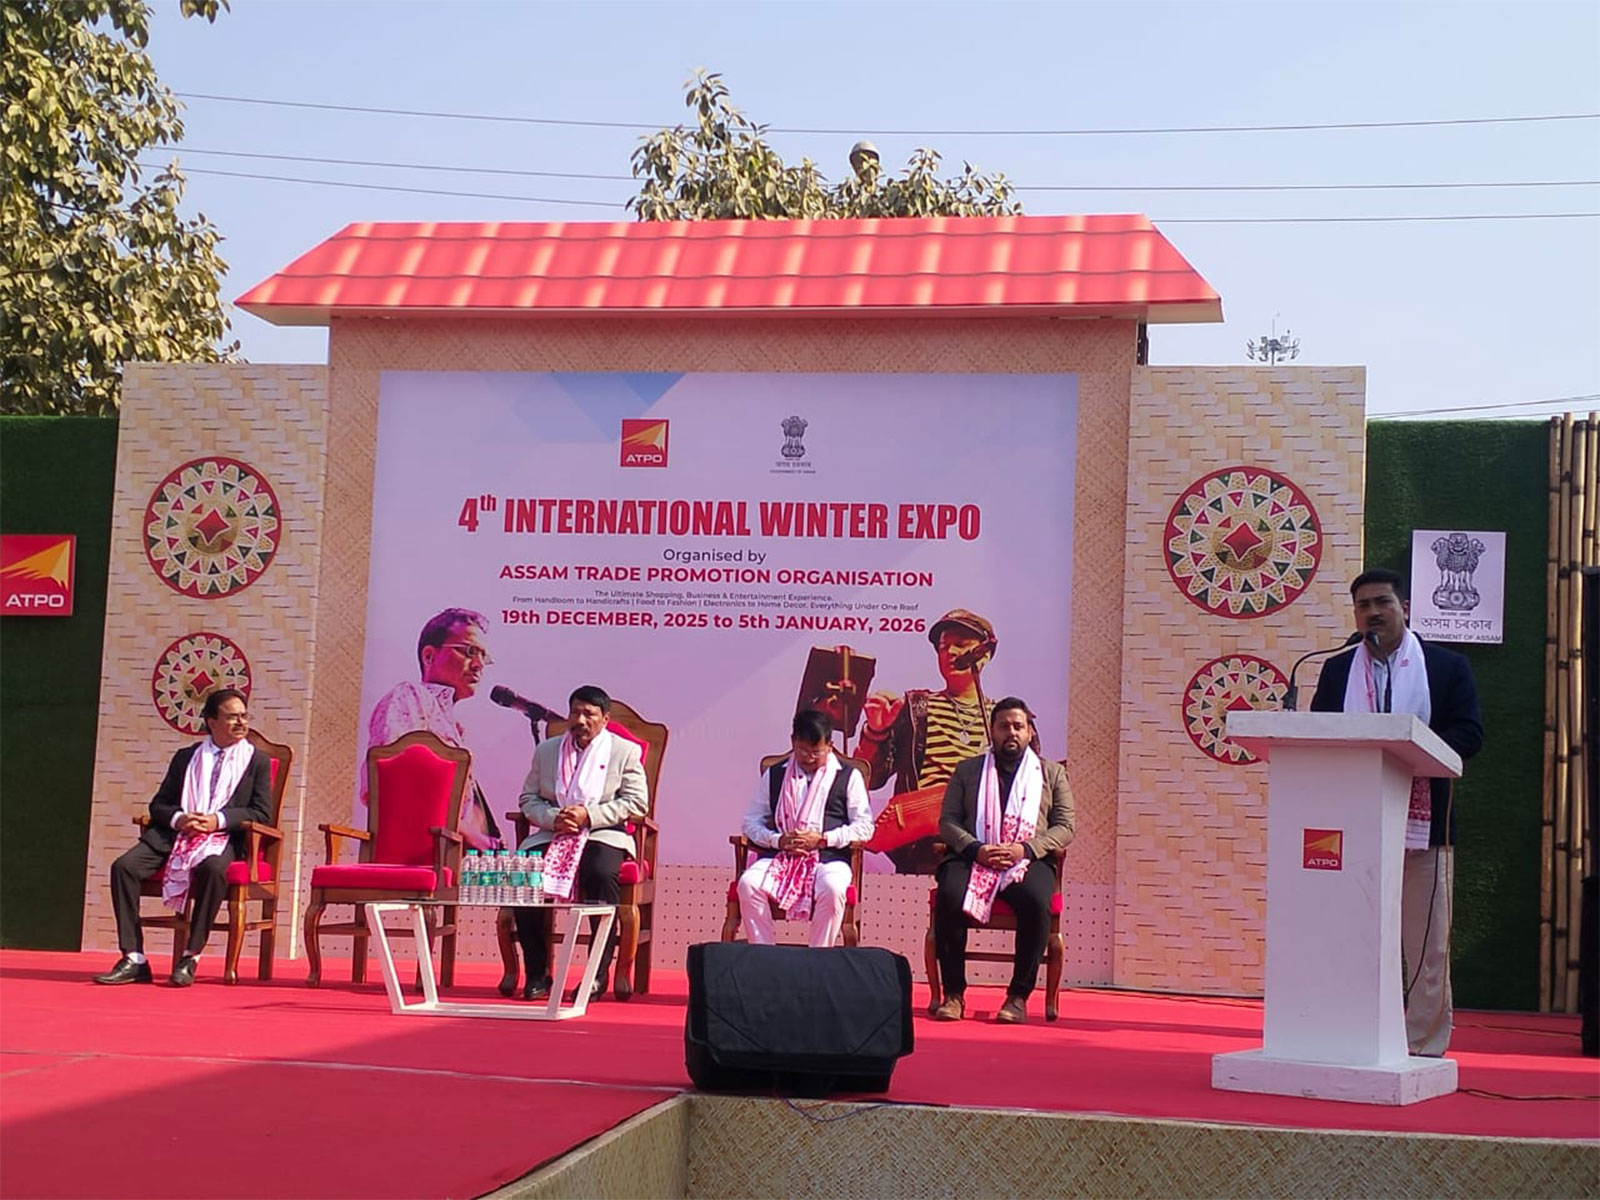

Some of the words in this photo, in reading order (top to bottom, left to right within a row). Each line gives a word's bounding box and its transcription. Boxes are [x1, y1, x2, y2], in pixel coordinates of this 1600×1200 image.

[625, 453, 663, 464] ATPO
[458, 494, 497, 533] 4th
[504, 498, 751, 537] INTERNATIONAL
[759, 501, 888, 539] WINTER
[897, 503, 982, 541] EXPO
[663, 547, 744, 564] Organised
[747, 548, 767, 565] by
[499, 564, 569, 582] ASSAM
[574, 566, 641, 582] TRADE
[647, 567, 771, 584] PROMOTION
[777, 569, 934, 588] ORGANISATION
[5, 593, 64, 608] ATPO
[595, 590, 609, 598] The
[611, 590, 644, 598] Ultimate
[686, 591, 720, 599] Business
[730, 592, 786, 601] Entertainment
[513, 596, 533, 604] From
[535, 596, 574, 604] Handloom
[586, 597, 630, 605] Handicrafts
[636, 598, 656, 606] Food
[667, 599, 698, 607] Fashion
[703, 599, 746, 607] Electronics
[758, 600, 781, 608] Home
[810, 602, 853, 611] Everything
[855, 603, 879, 611] Under
[881, 603, 898, 611] One
[900, 603, 919, 611] Roof
[502, 610, 541, 625] 19th
[546, 610, 658, 629] DECEMBER,
[664, 613, 708, 628] 2025
[713, 614, 732, 628] to
[738, 614, 770, 629] 5th
[775, 615, 873, 634] JANUARY,
[879, 617, 926, 633] 2026
[1476, 634, 1501, 642] ASSAM
[1308, 858, 1339, 867] ATPO
